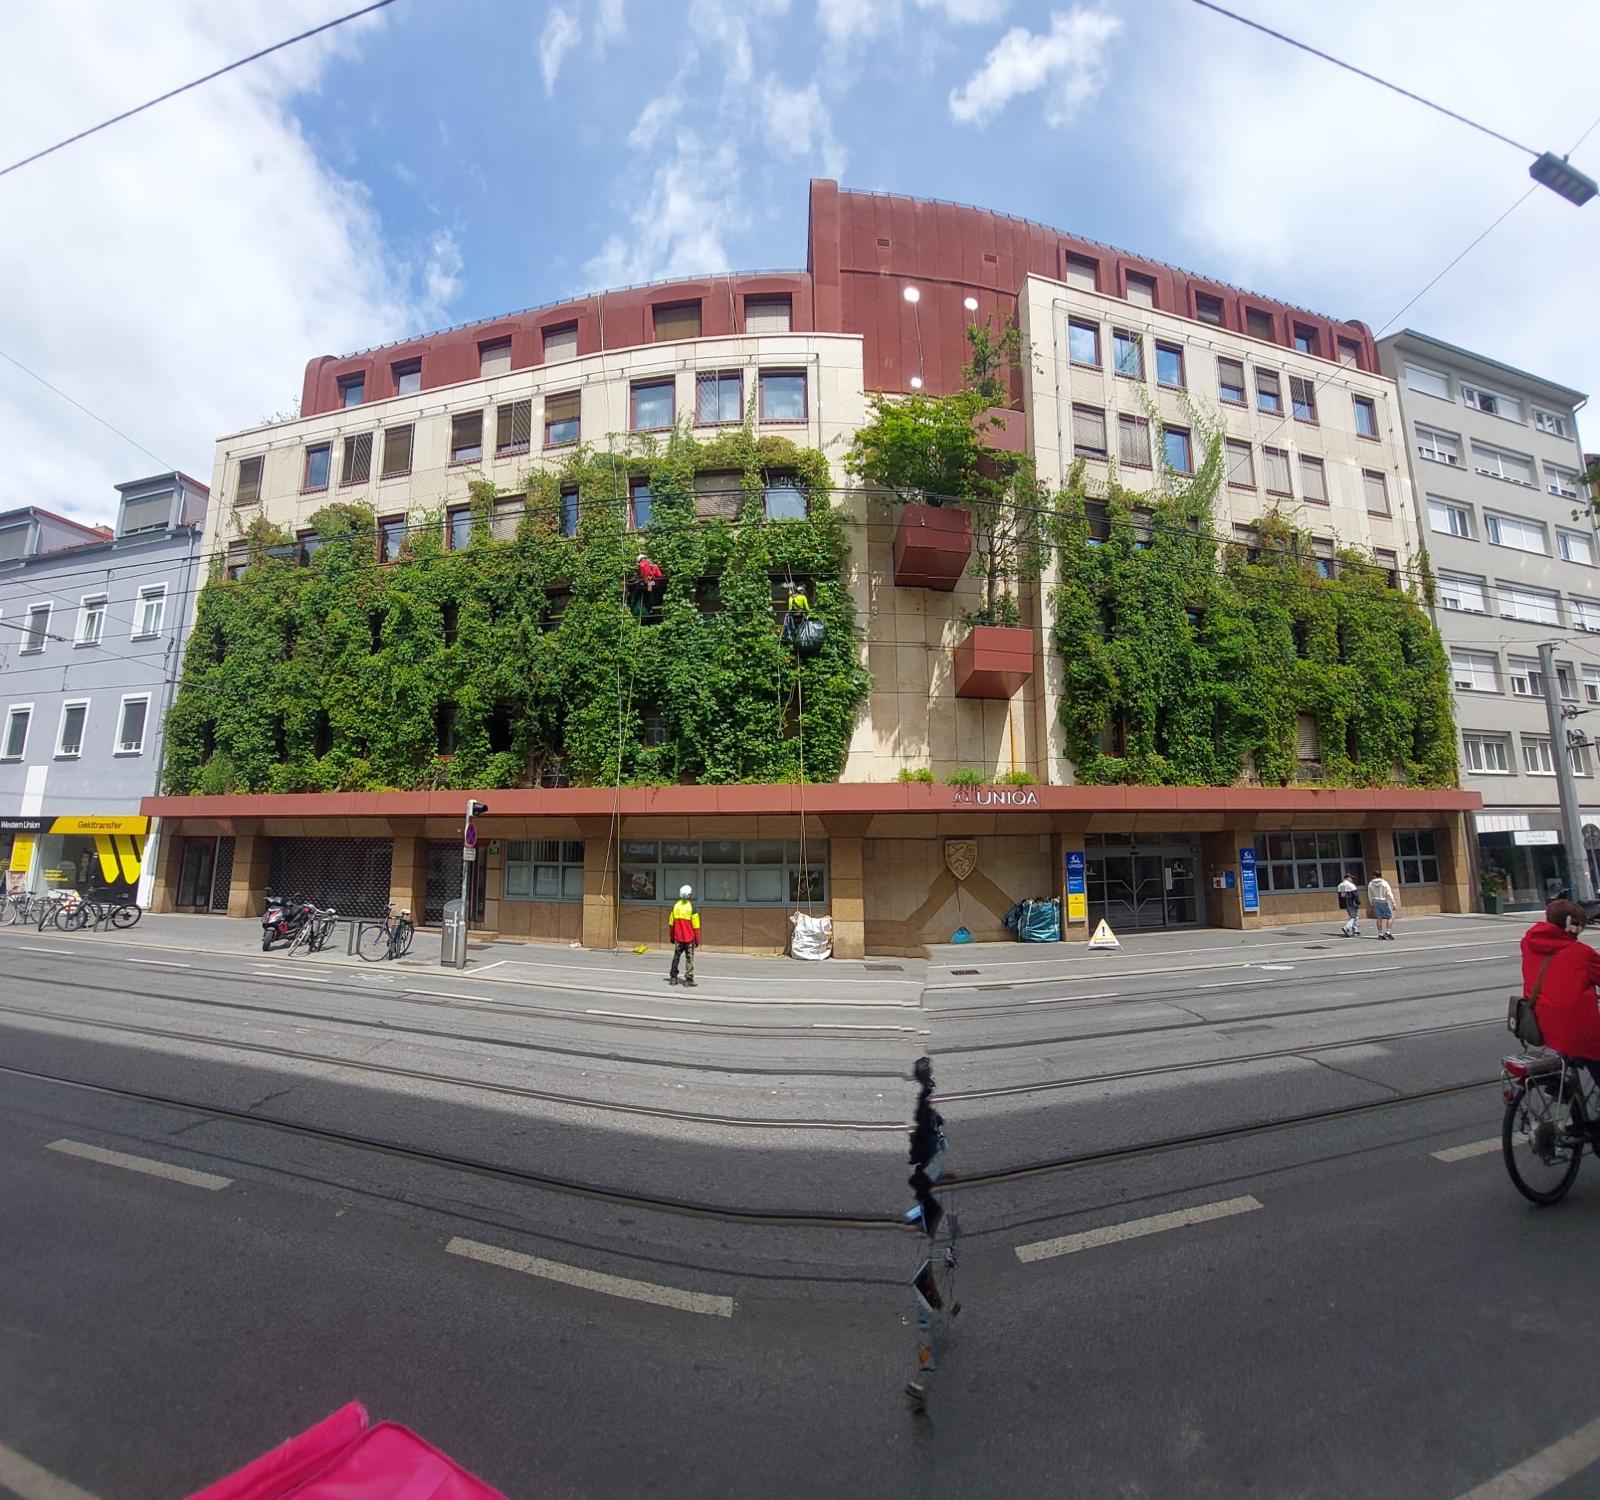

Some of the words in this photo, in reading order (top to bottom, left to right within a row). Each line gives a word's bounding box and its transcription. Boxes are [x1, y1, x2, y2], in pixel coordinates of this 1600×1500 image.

[977, 791, 1038, 805] UNIQA
[1, 821, 23, 829] Western
[24, 820, 41, 829] Union
[77, 820, 122, 830] Geldtransfer
